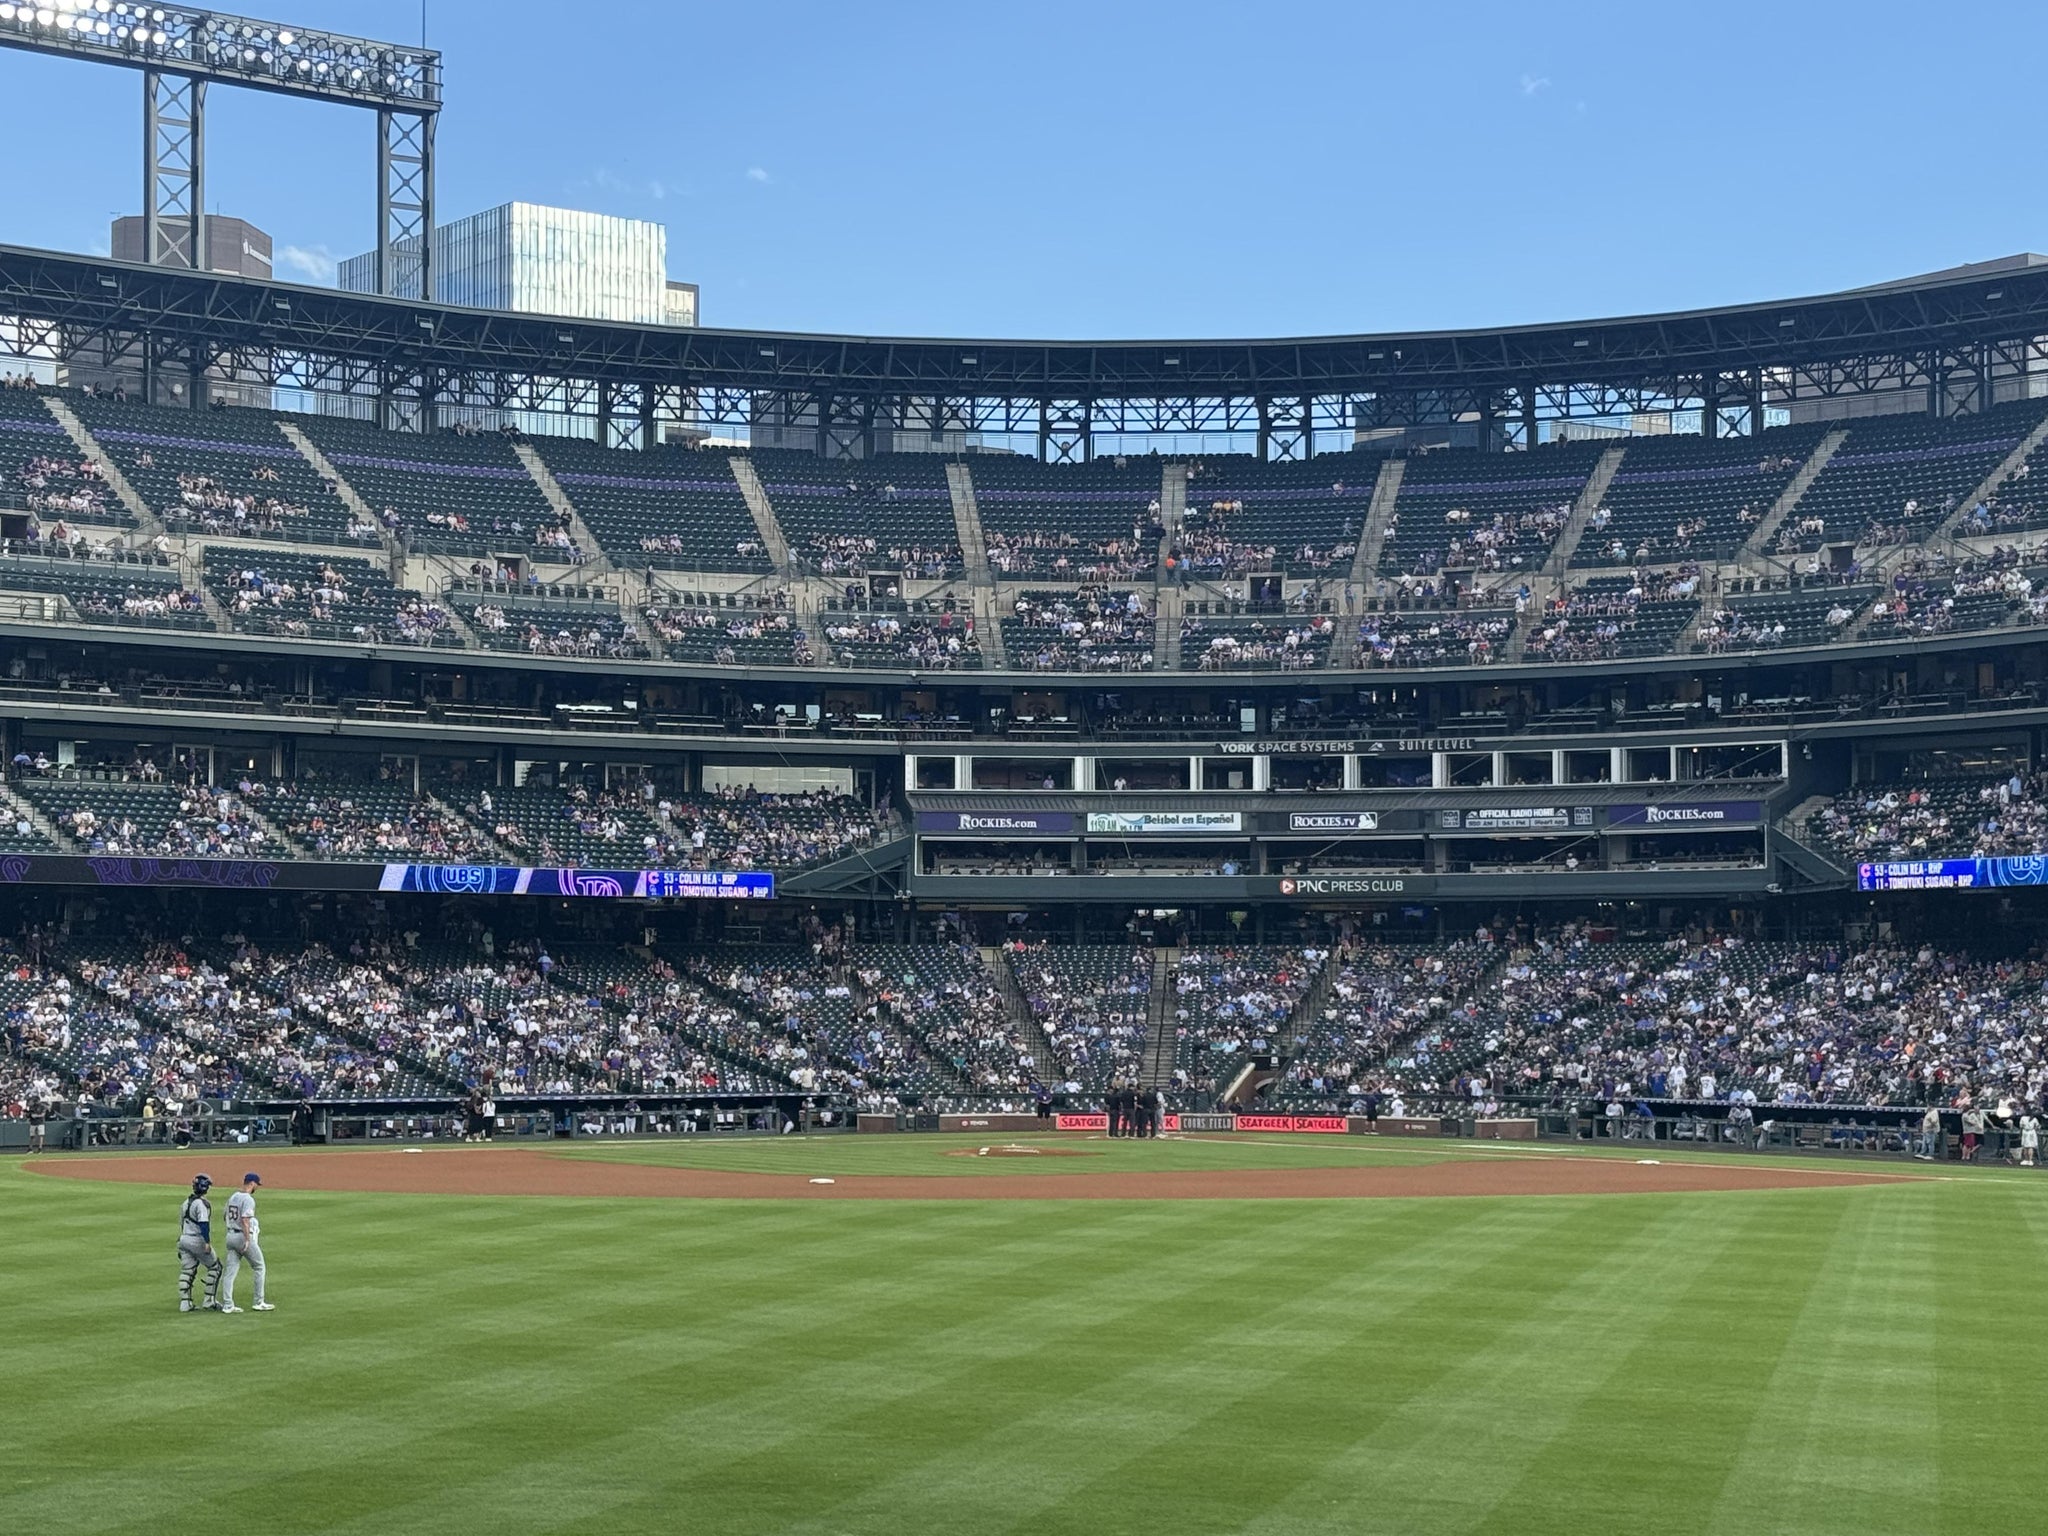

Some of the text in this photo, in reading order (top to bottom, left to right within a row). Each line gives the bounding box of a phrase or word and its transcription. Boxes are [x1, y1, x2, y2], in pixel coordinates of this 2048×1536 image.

[1219, 742, 1355, 753] YORK SPACE SYSTEMS
[1399, 739, 1472, 751] SUITE LEVEL
[1479, 808, 1554, 818] OFFICIAL RADIO HOME
[1645, 806, 1724, 823] ROCKIES.com
[958, 814, 1038, 830] ROCKIES.com
[1196, 814, 1234, 826] Español
[87, 858, 280, 887] ROCKIES
[1874, 865, 1884, 876] 53
[1888, 864, 1908, 876] COLIN
[1910, 863, 1924, 875] REA
[663, 873, 674, 884] 53
[679, 873, 702, 884] COLIN
[702, 874, 717, 884] REA
[722, 874, 737, 885] RHP
[1875, 877, 1884, 889] 11
[664, 885, 673, 896] 11
[679, 886, 717, 897] TOMOYUKI
[718, 887, 748, 897] SUGANO
[753, 887, 769, 897] RHP
[1296, 880, 1404, 893] PNC PRESS CLUB
[1061, 1117, 1106, 1127] SEATGEE
[1183, 1118, 1205, 1129] COORS
[1210, 1117, 1231, 1129] FIELD
[1240, 1117, 1289, 1131] SEATGEEK
[1296, 1117, 1343, 1130] SEATGEEK
[229, 1205, 239, 1221] 53
